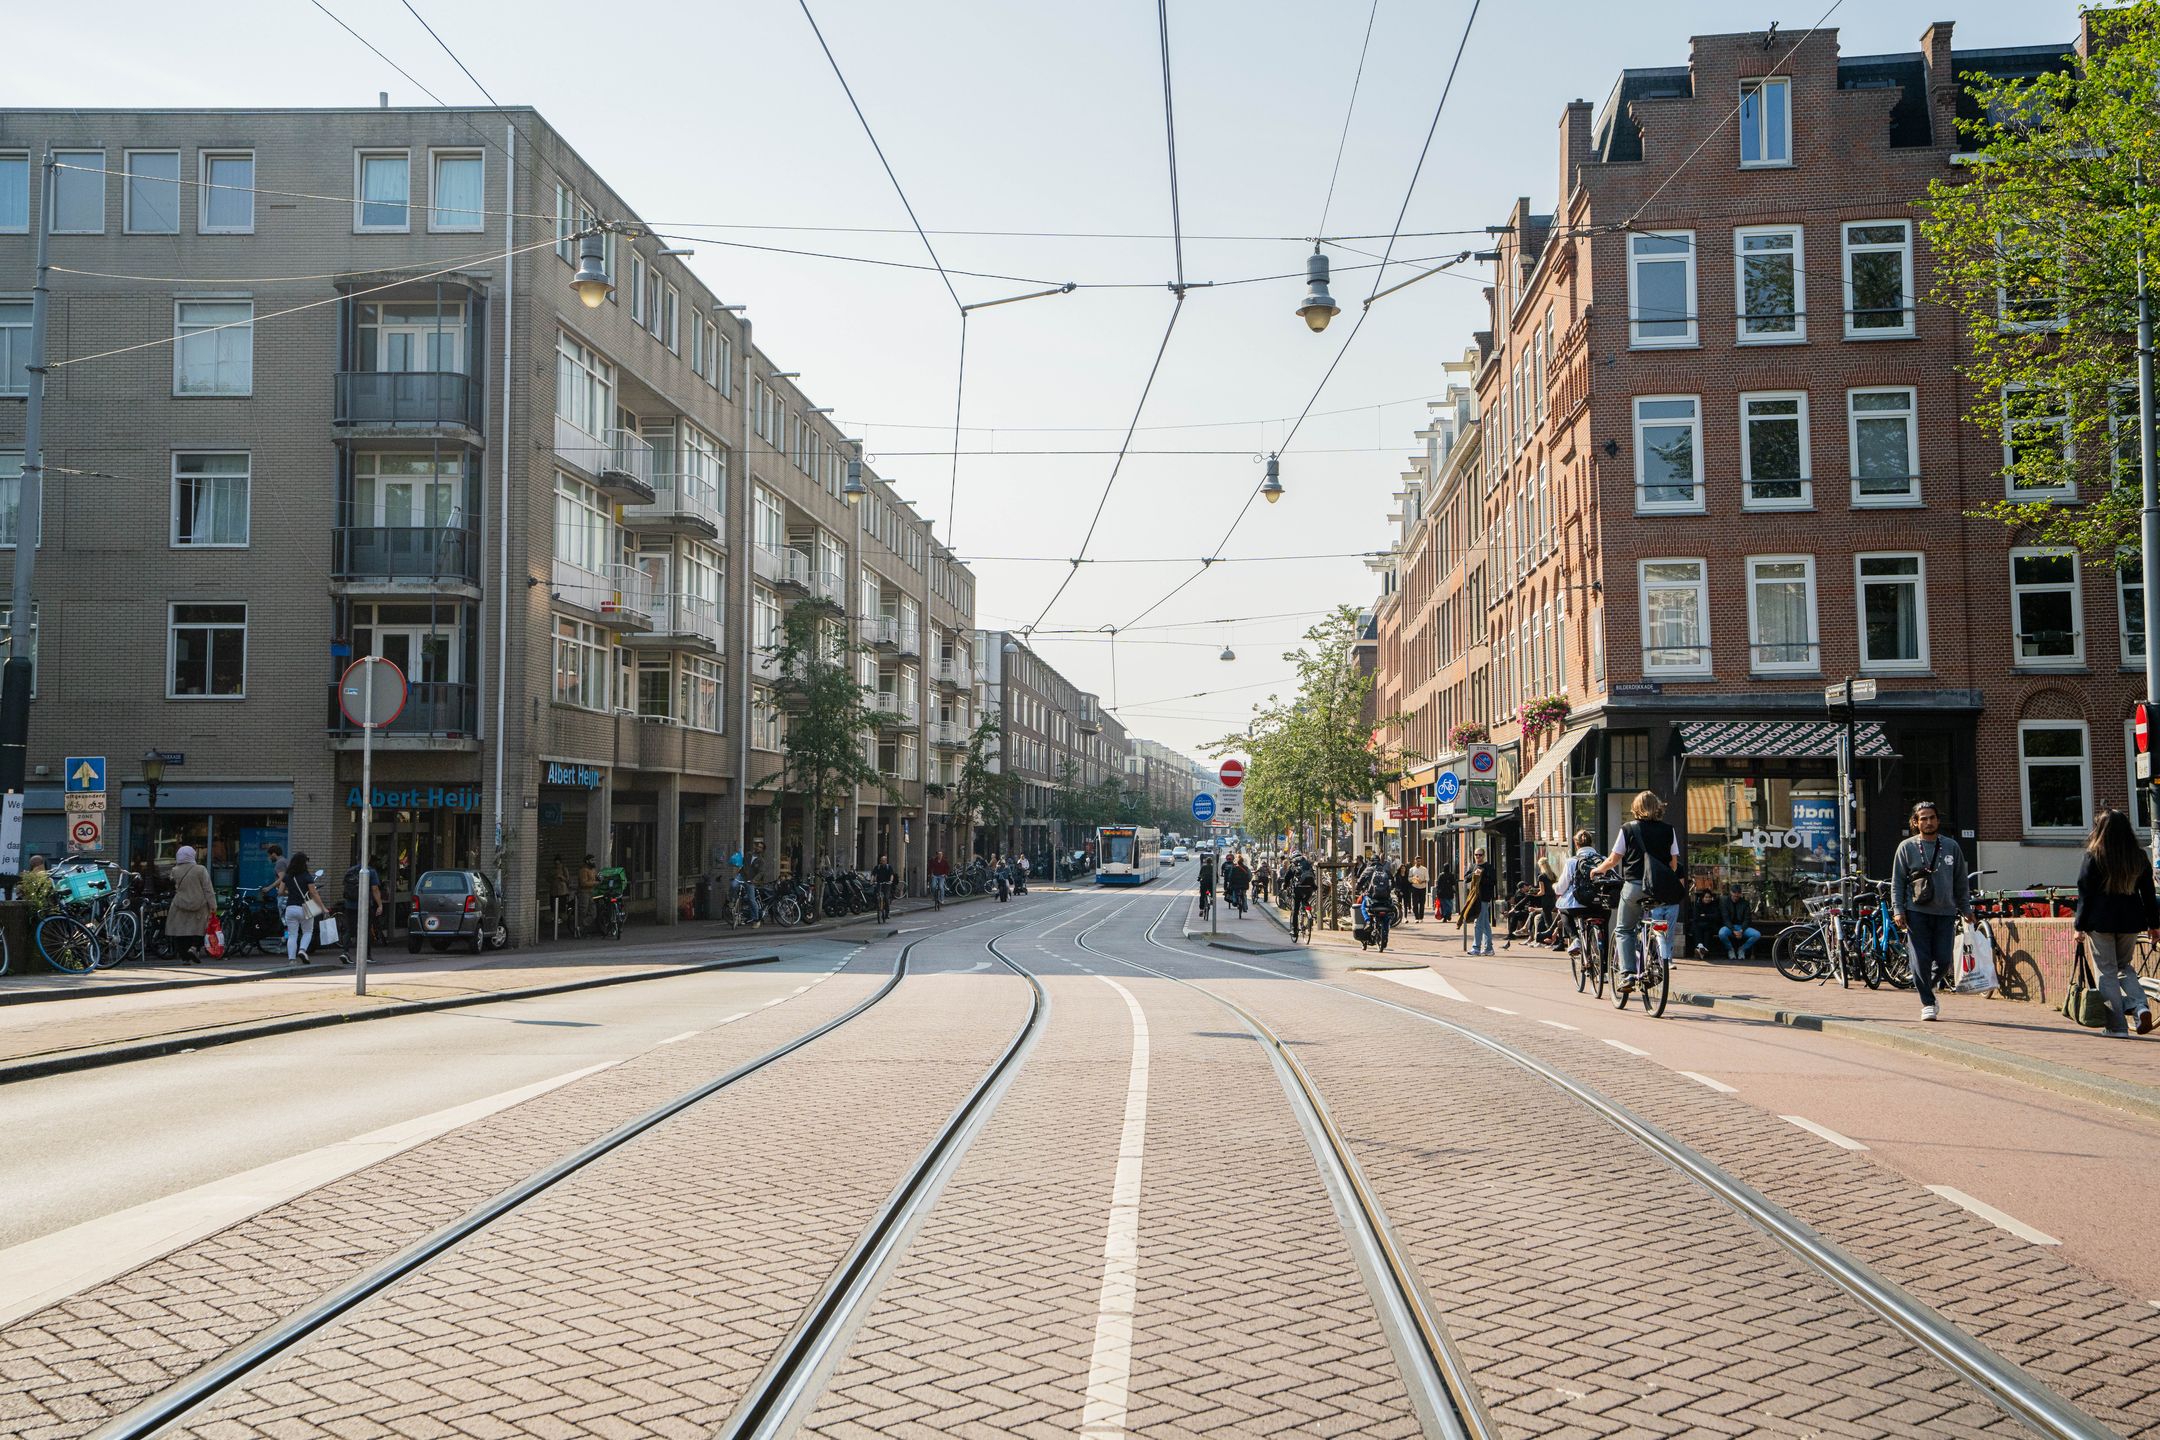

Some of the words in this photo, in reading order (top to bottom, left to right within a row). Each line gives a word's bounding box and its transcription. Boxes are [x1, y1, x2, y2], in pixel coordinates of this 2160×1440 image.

[547, 762, 576, 785] Albert
[577, 764, 599, 790] Heijn
[346, 786, 421, 808] Abert
[78, 827, 94, 836] 30
